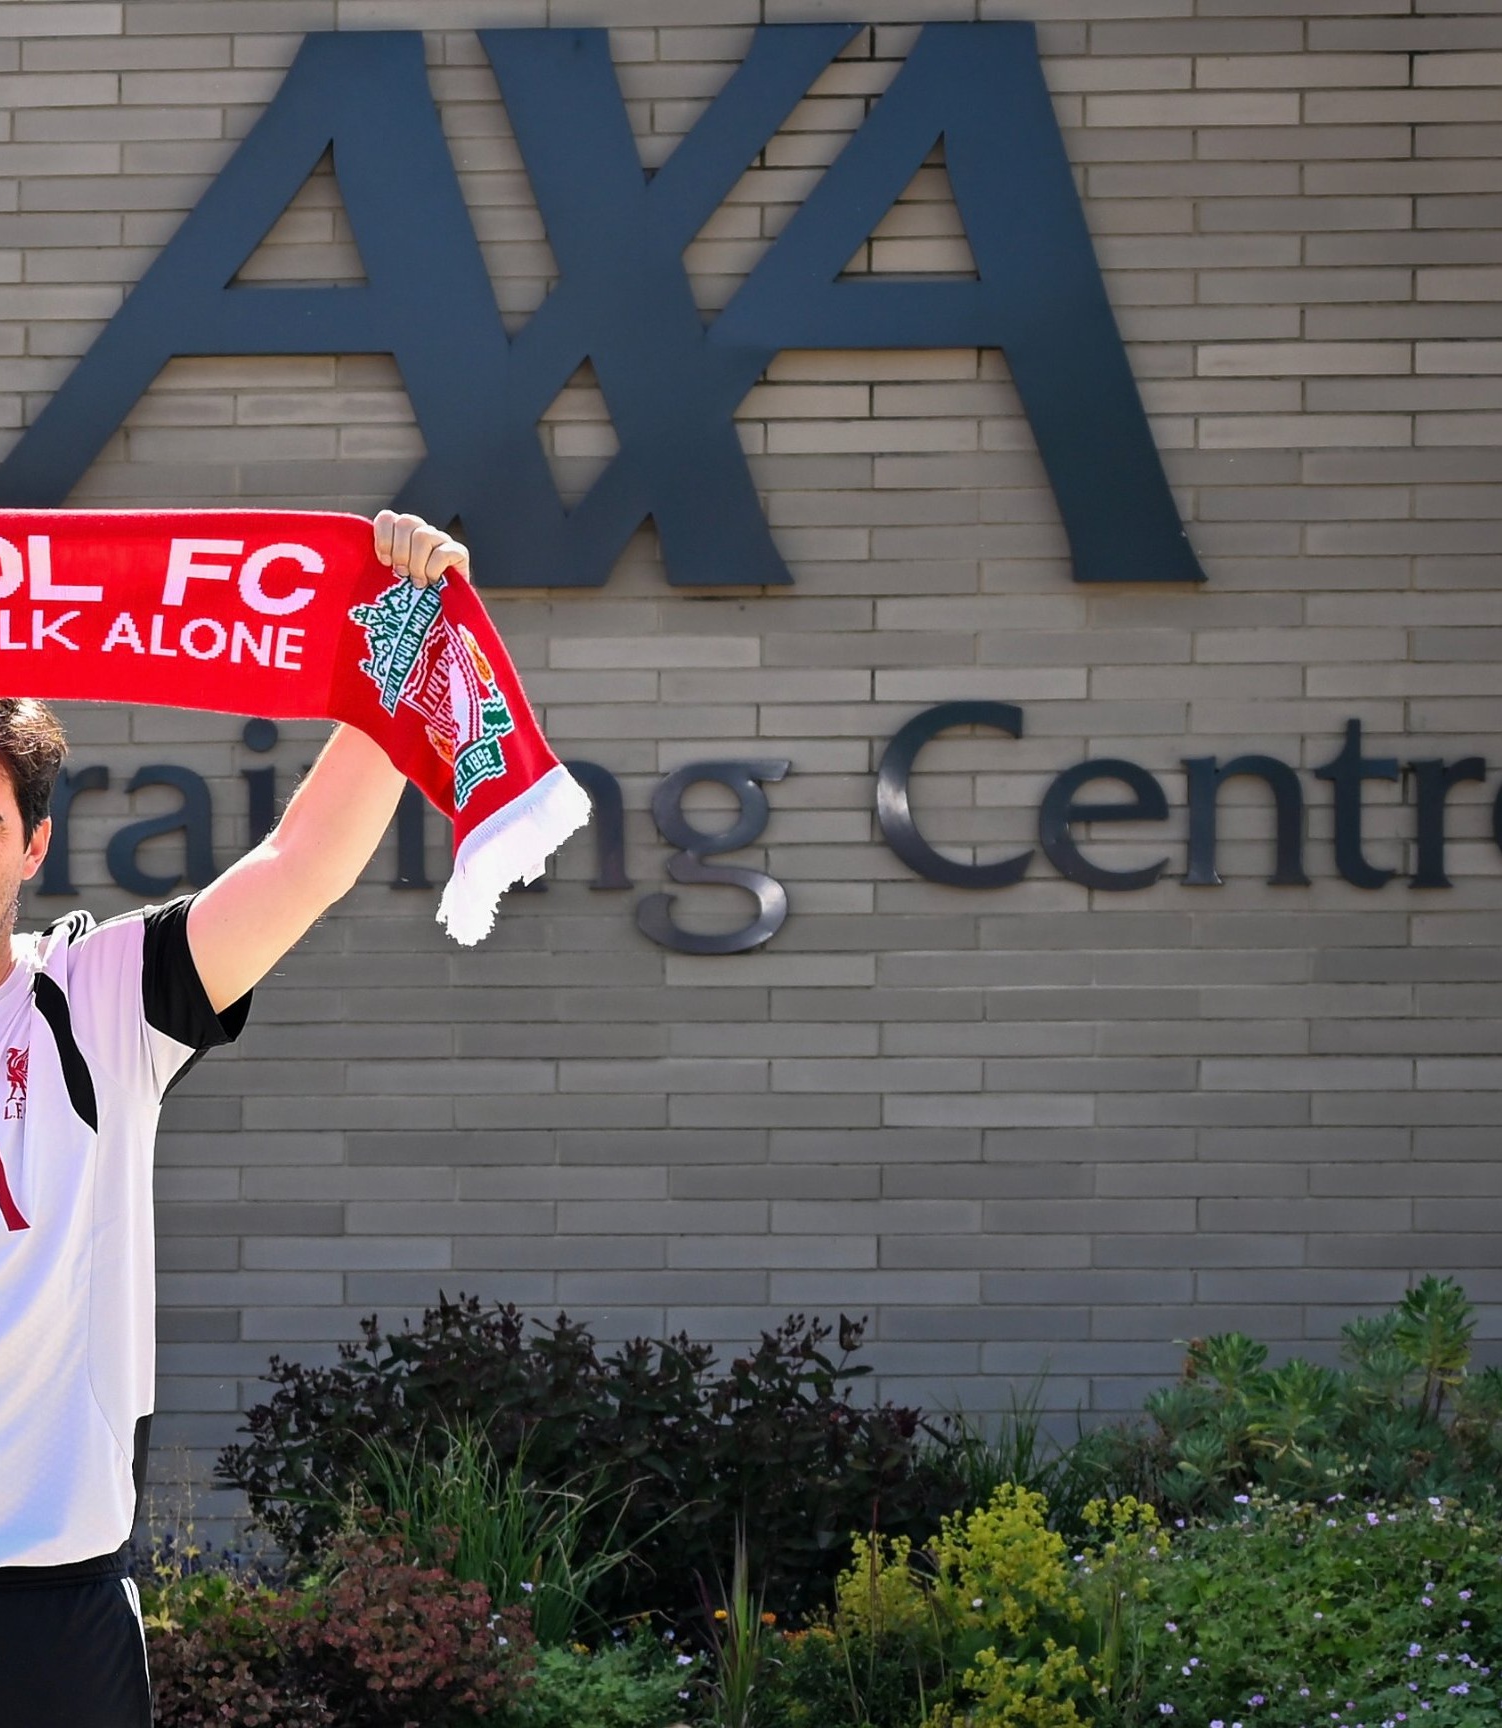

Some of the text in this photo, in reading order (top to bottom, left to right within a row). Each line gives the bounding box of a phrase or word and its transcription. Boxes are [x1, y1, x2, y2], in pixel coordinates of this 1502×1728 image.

[163, 539, 324, 615] FC
[102, 613, 304, 669] ALONE
[877, 700, 1502, 891] Centr
